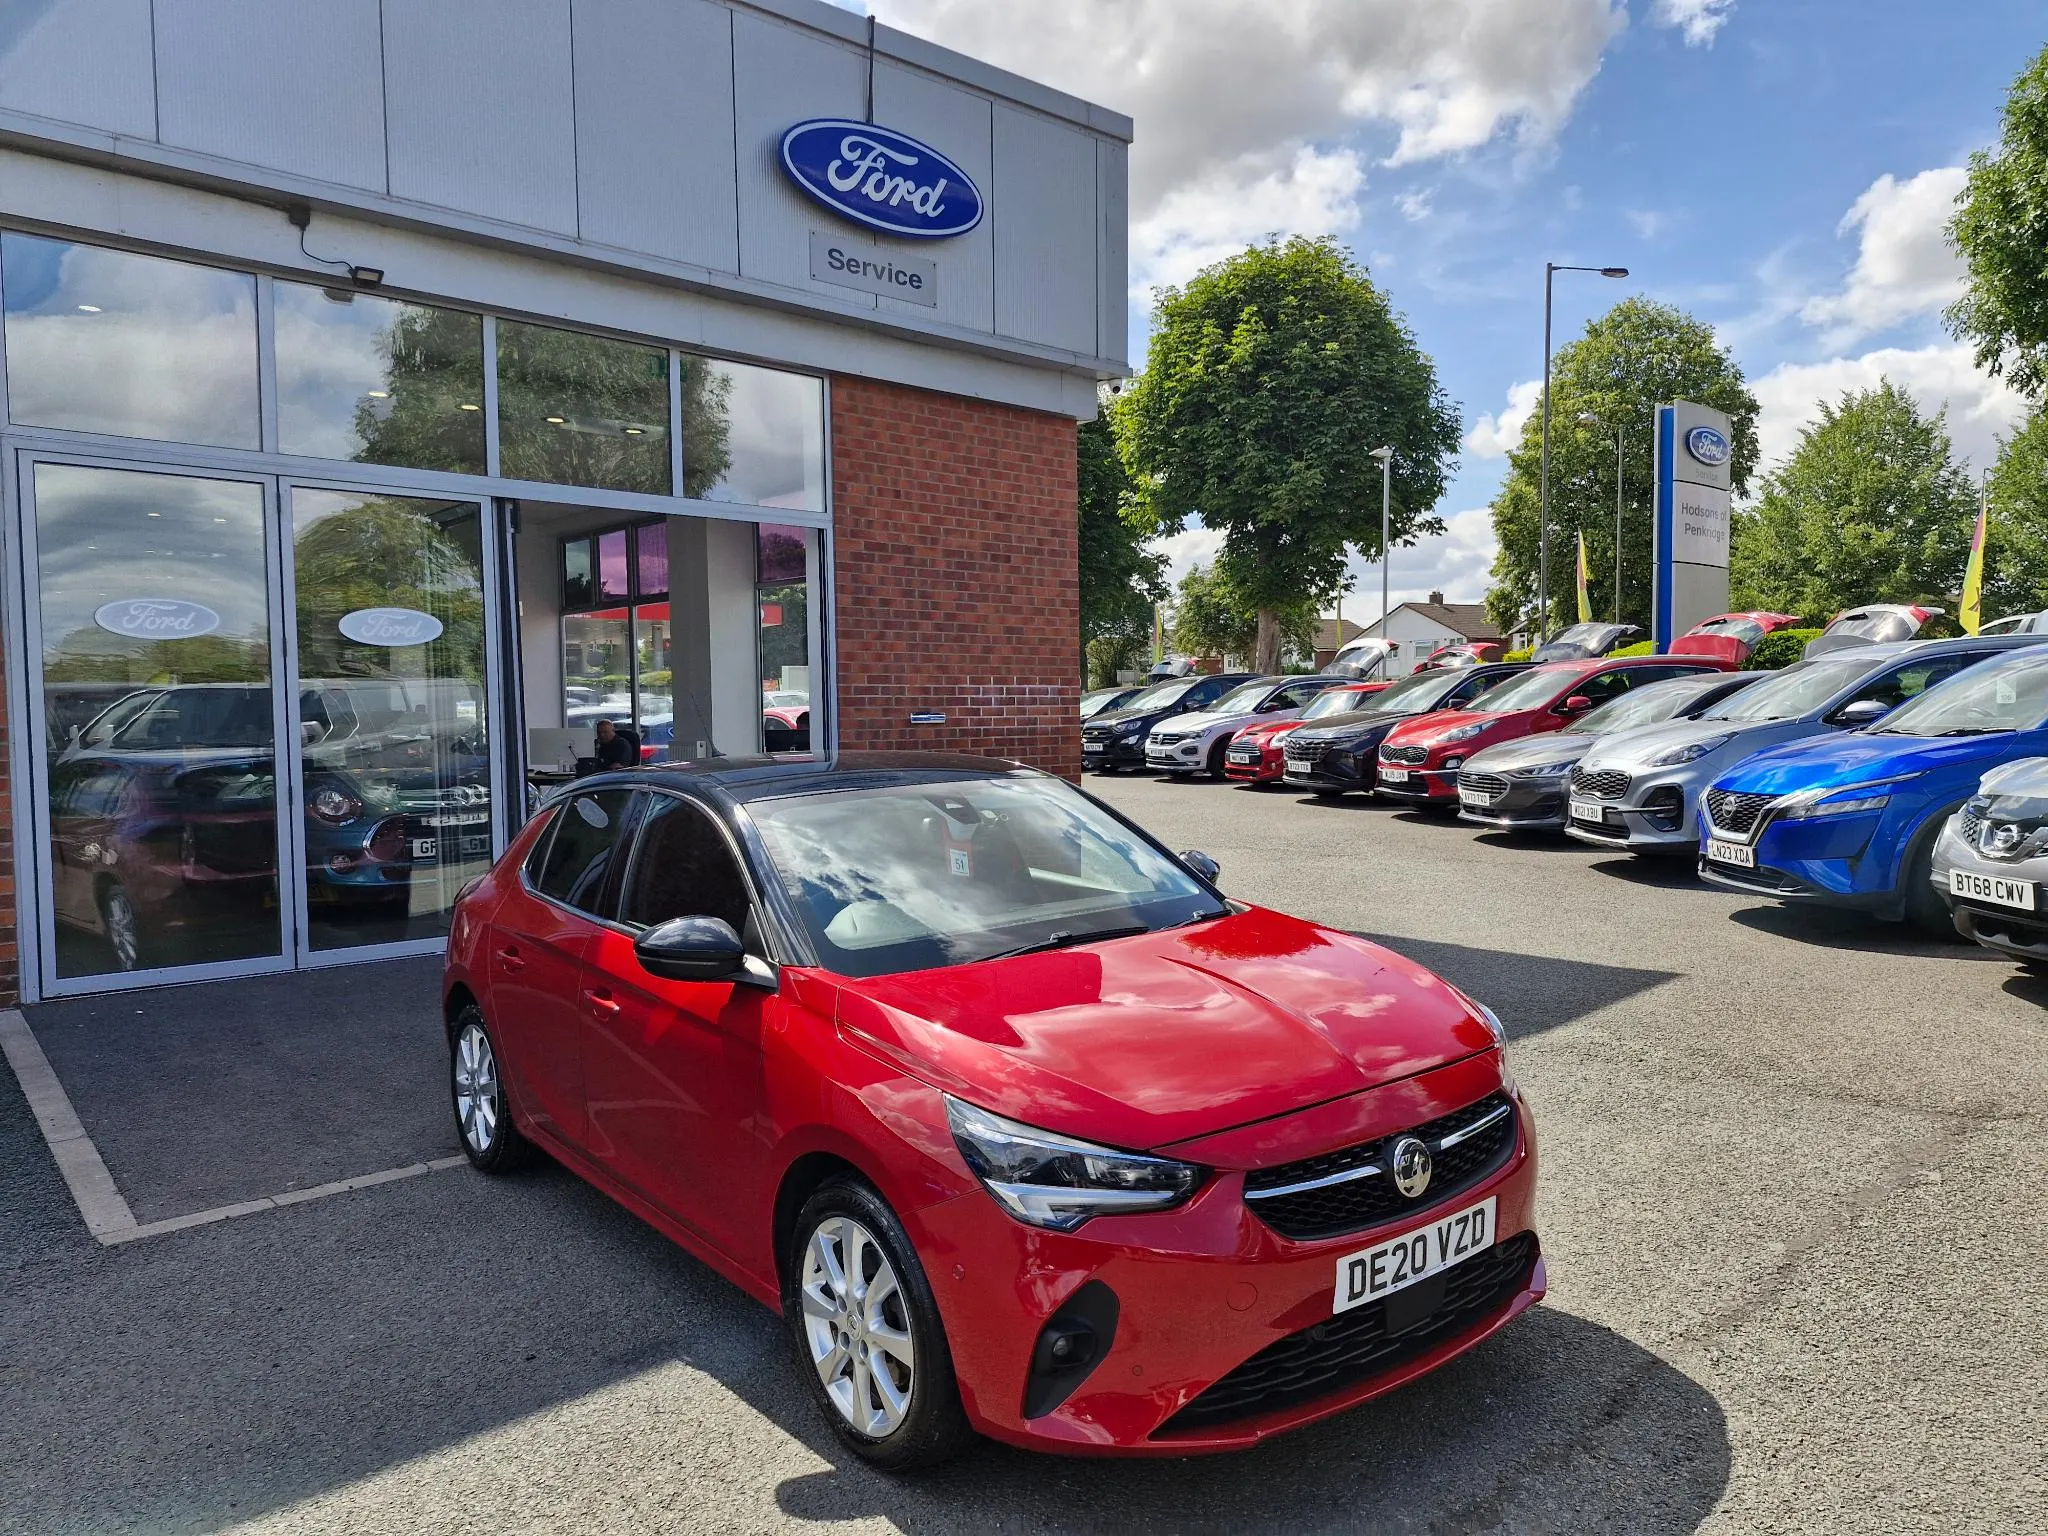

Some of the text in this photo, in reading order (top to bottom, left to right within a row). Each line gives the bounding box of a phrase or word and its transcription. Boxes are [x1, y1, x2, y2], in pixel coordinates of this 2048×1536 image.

[827, 136, 950, 218] Ford
[827, 248, 923, 290] Service
[1698, 432, 1723, 459] Ford
[1681, 502, 1727, 521] Hodsons of
[1684, 523, 1725, 542] Penkridge
[122, 602, 195, 631] Ford
[361, 614, 421, 638] Ford
[1711, 842, 1751, 864] LN23 XDA
[1956, 873, 2024, 903] BT68 CWV
[1347, 1207, 1486, 1302] DE20 VZD
